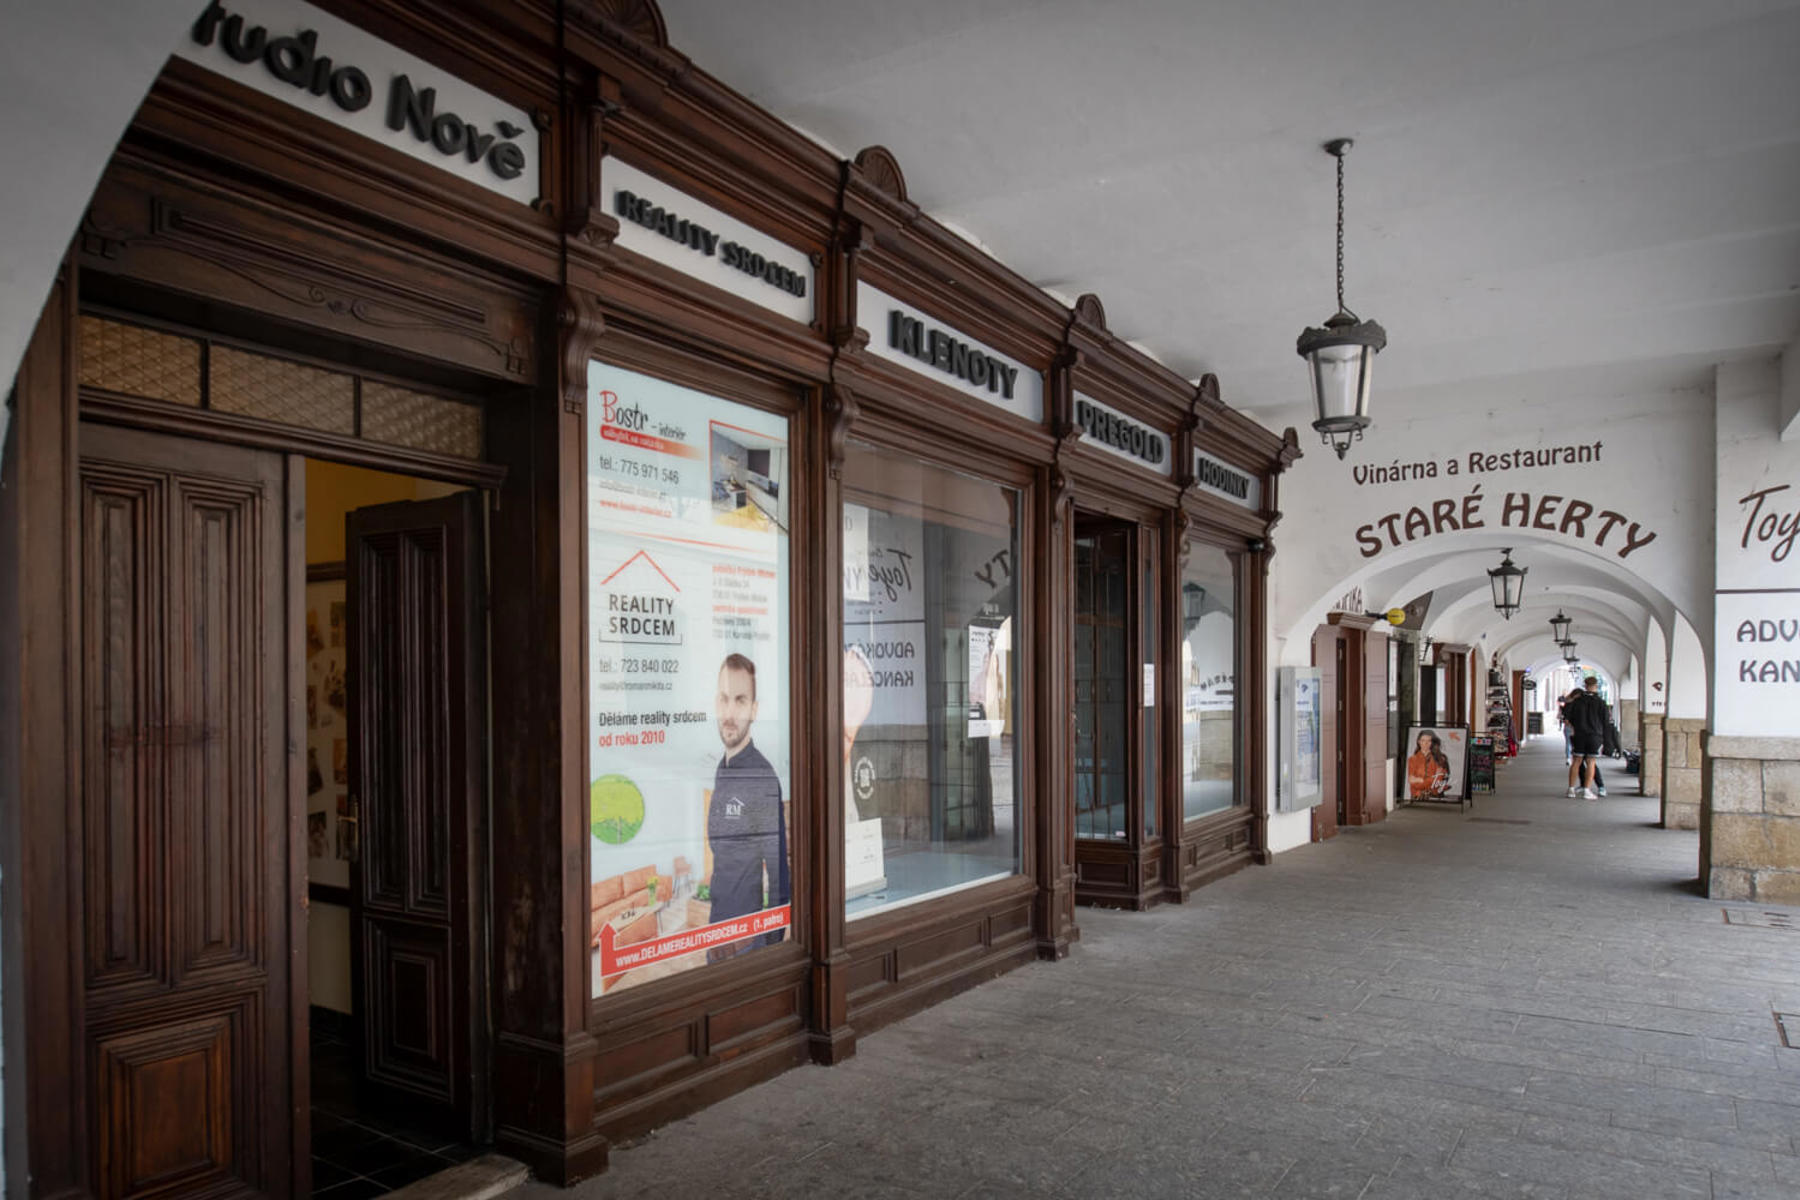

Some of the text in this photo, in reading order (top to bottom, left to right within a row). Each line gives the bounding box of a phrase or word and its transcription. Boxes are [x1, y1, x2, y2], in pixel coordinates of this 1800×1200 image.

[386, 75, 525, 180] Nově
[614, 190, 806, 298] REALITY SRDCEM
[888, 310, 1018, 399] KLENOTY
[1077, 400, 1164, 464] PREGOLD
[620, 459, 639, 476] 775
[641, 464, 658, 479] 971
[1353, 441, 1603, 485] Vinárna a Restaurant
[1355, 484, 1657, 558] STARÉ HERTY
[609, 593, 674, 615] REALITY
[609, 616, 675, 637] SRDCEM
[1737, 619, 1800, 642] ADV
[620, 659, 639, 673] 723
[641, 659, 660, 673] 840
[640, 710, 671, 727] reality
[673, 710, 706, 723] srdcem
[599, 730, 665, 747] od roku 2010
